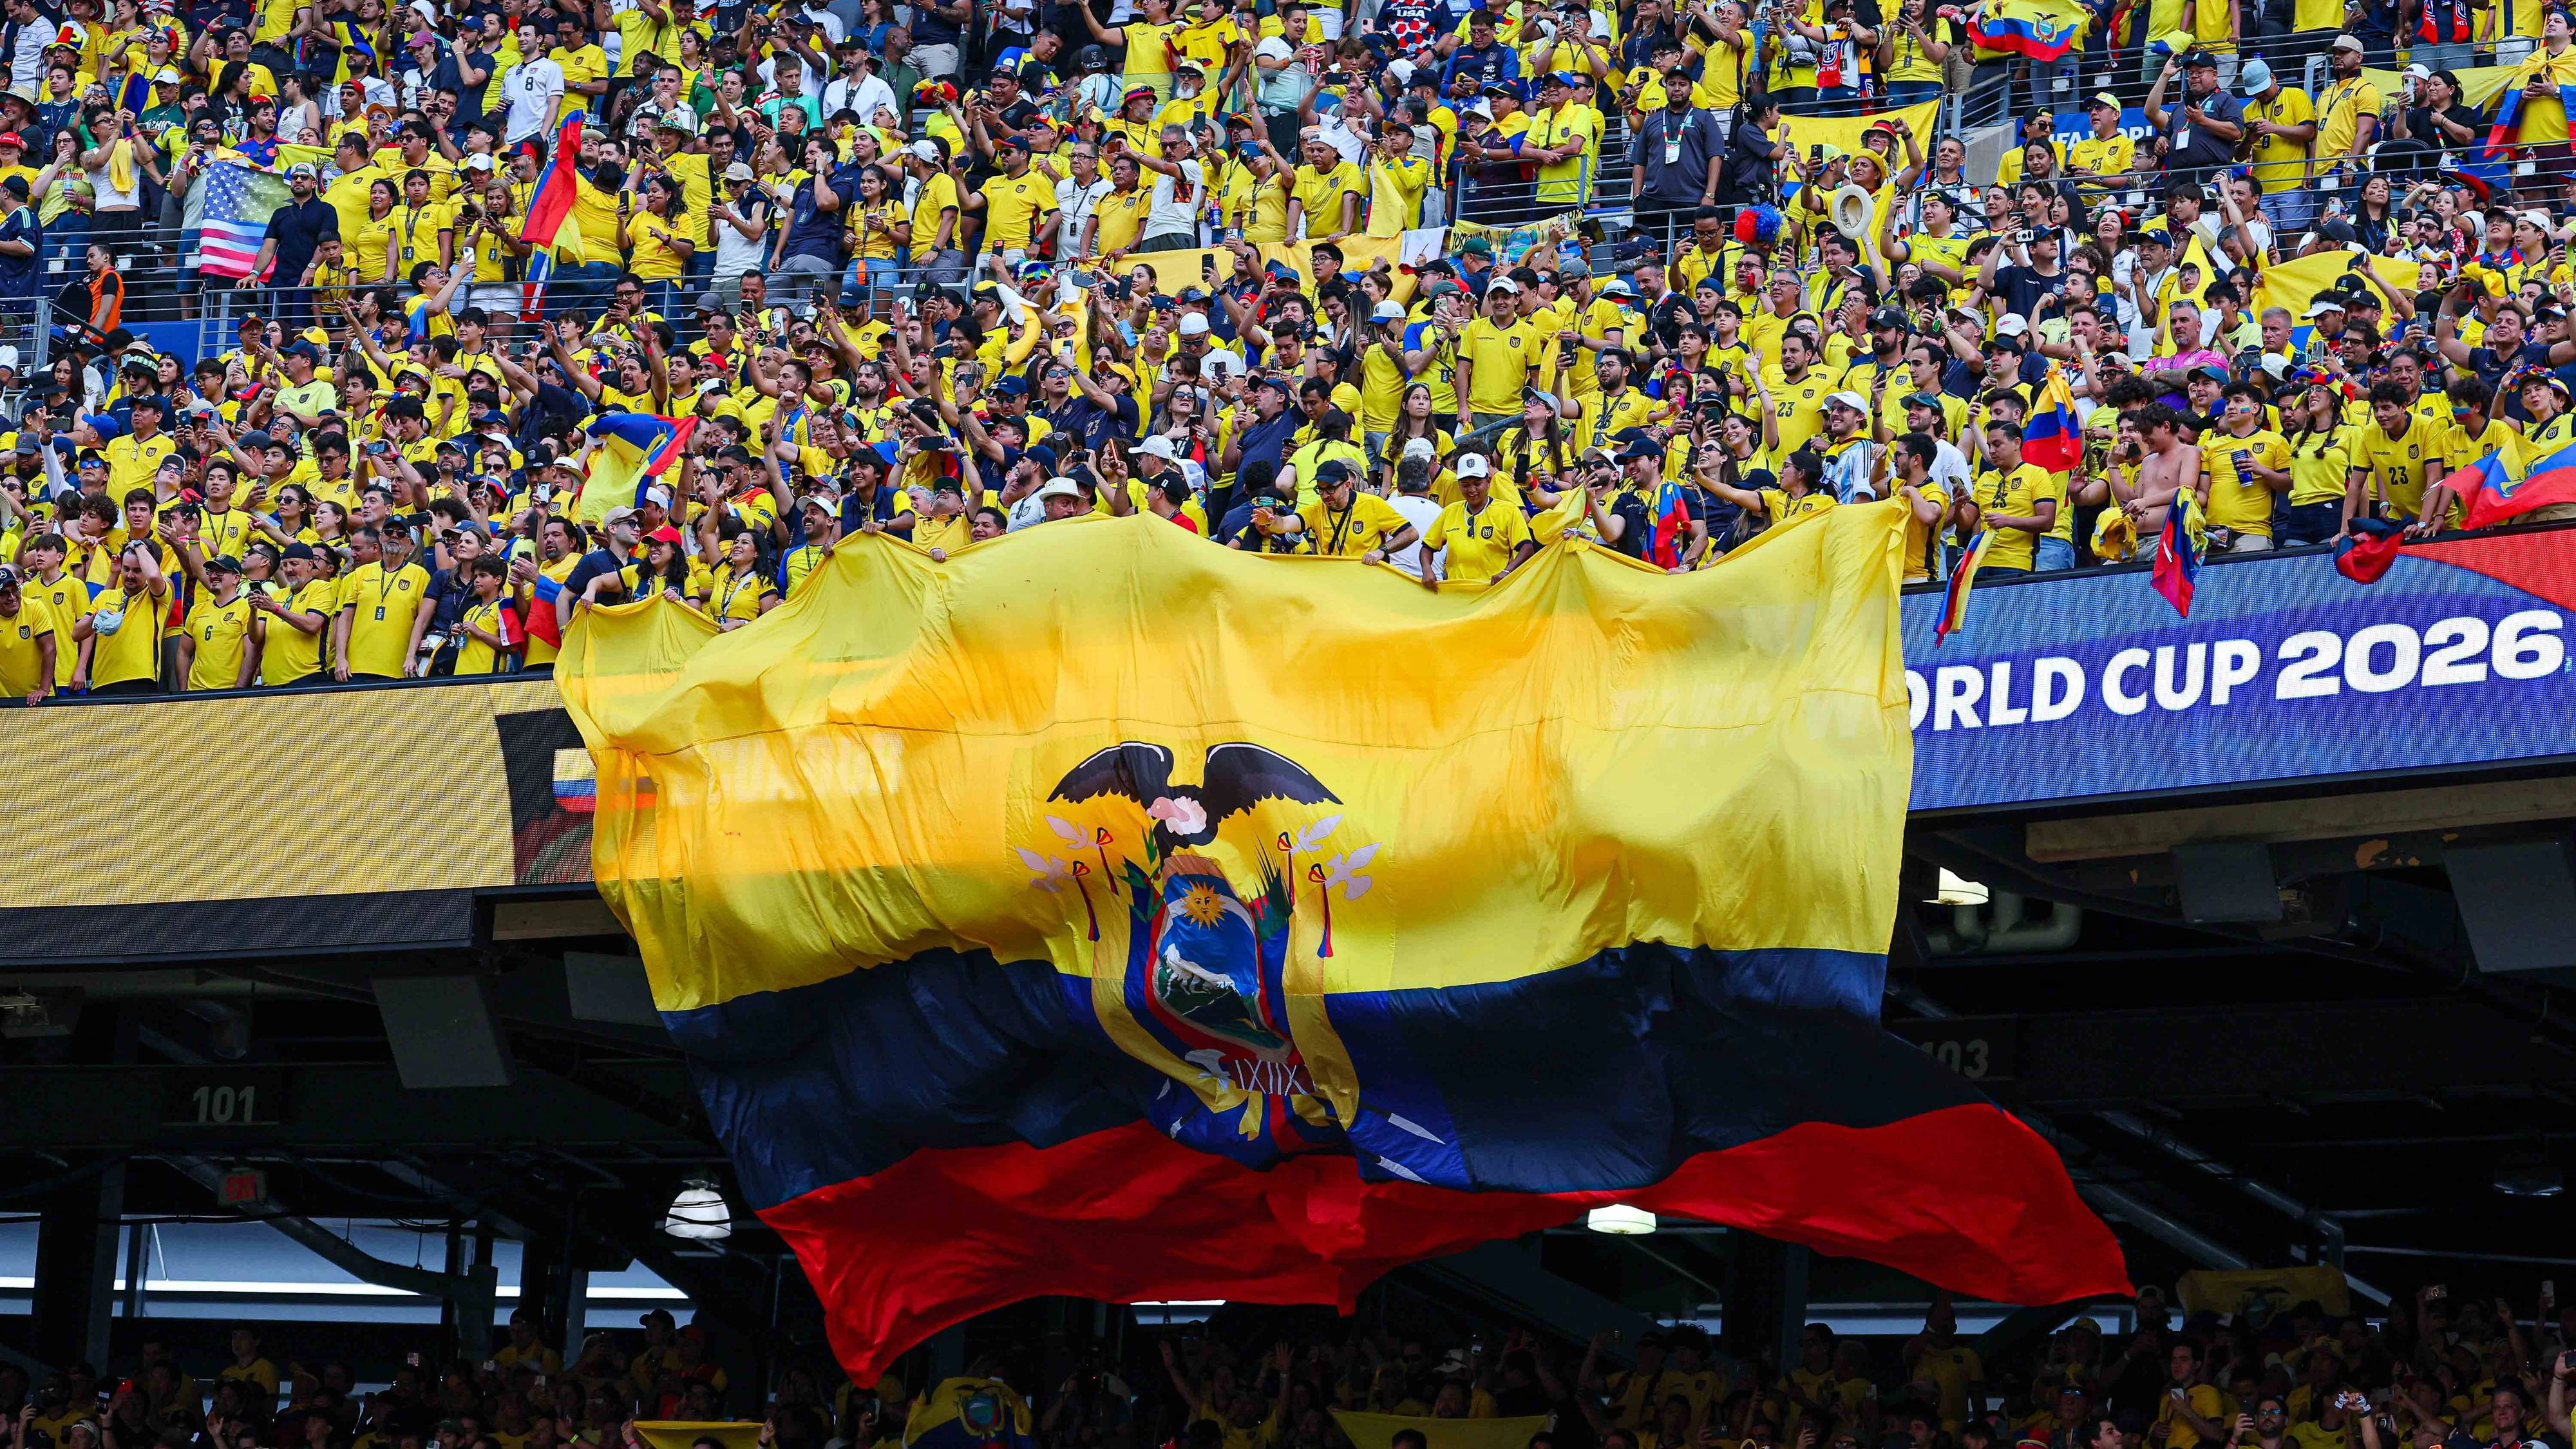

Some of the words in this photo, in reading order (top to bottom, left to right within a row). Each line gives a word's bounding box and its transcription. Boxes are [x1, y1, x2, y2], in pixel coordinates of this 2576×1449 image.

[1397, 10, 1425, 19] USA
[525, 77, 534, 91] 8
[2090, 157, 2103, 171] 23
[2352, 290, 2362, 299] NY
[1777, 402, 1794, 417] 23
[1086, 419, 1099, 437] 23
[2389, 466, 2409, 485] 23
[204, 625, 213, 641] 6
[1905, 657, 2085, 730] RLD
[2103, 640, 2260, 715] CUP
[2276, 610, 2564, 699] 2026
[1921, 1039, 1989, 1079] 03
[193, 1086, 255, 1123] 101
[226, 1176, 256, 1200] EXIT
